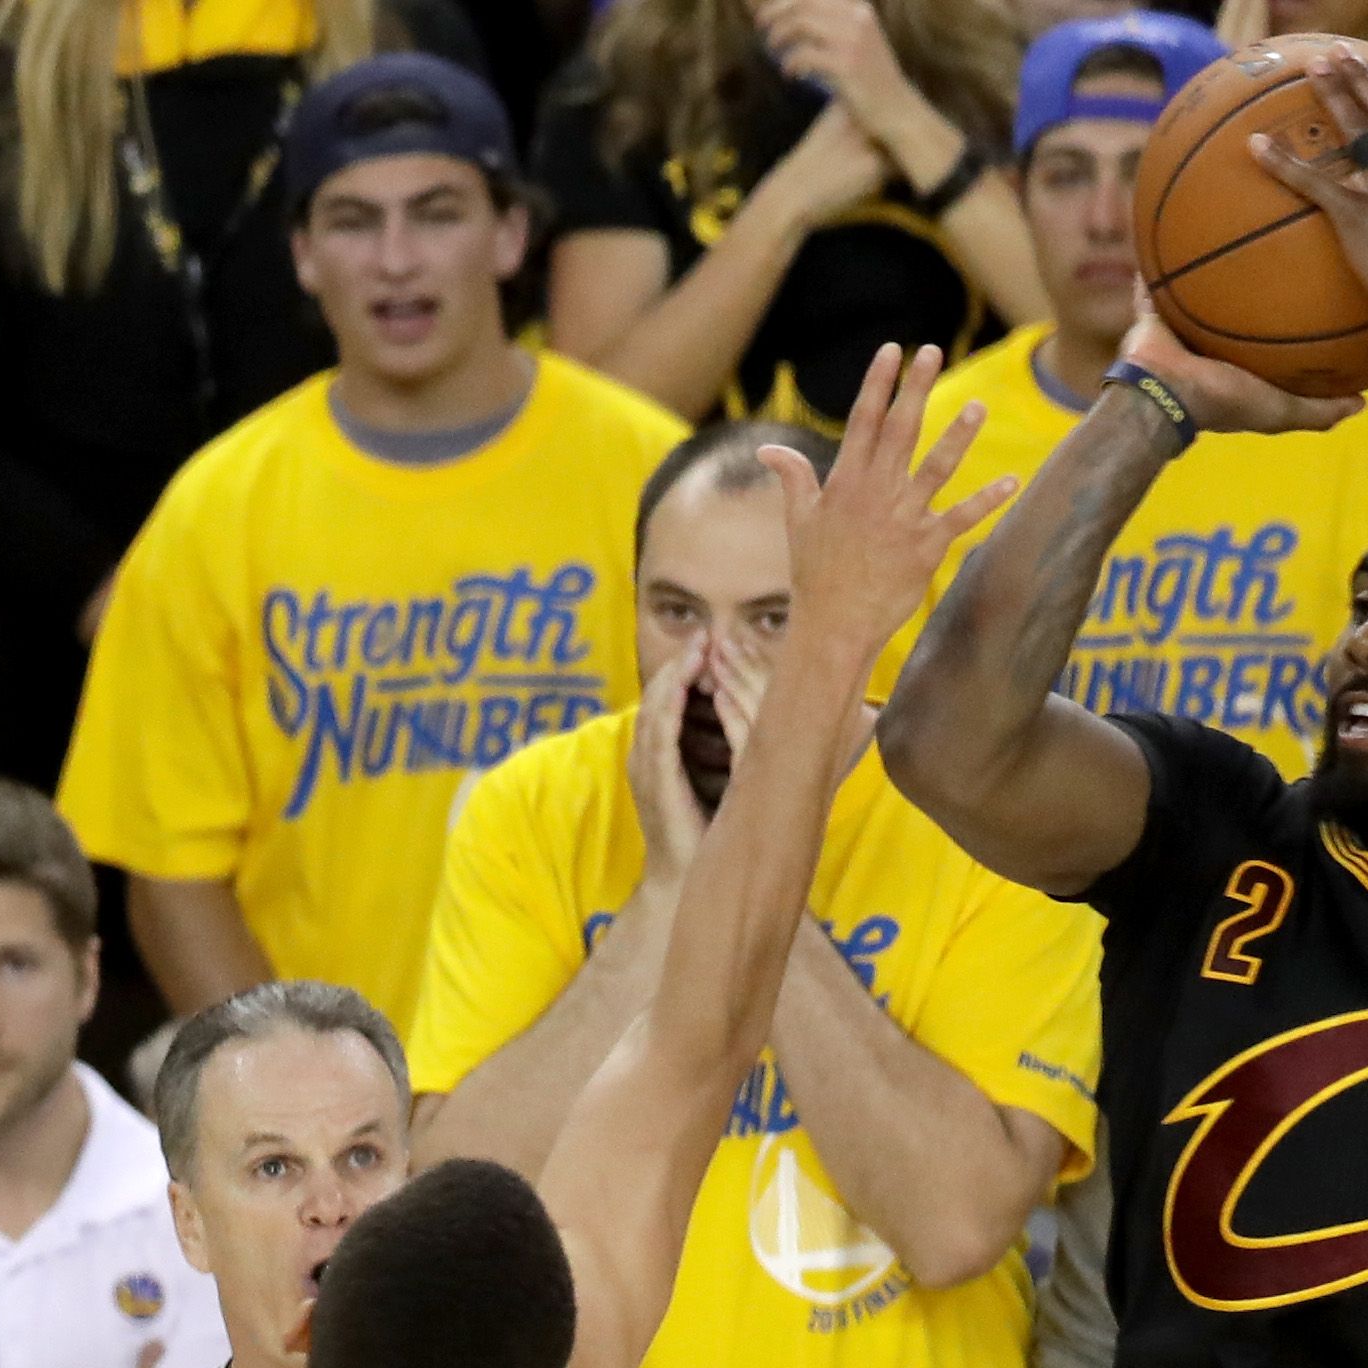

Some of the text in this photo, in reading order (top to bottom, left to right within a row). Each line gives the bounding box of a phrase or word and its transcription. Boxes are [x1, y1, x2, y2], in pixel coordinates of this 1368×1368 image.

[1087, 524, 1299, 646] ngth
[264, 564, 596, 739] Strength
[1200, 860, 1294, 985] 2
